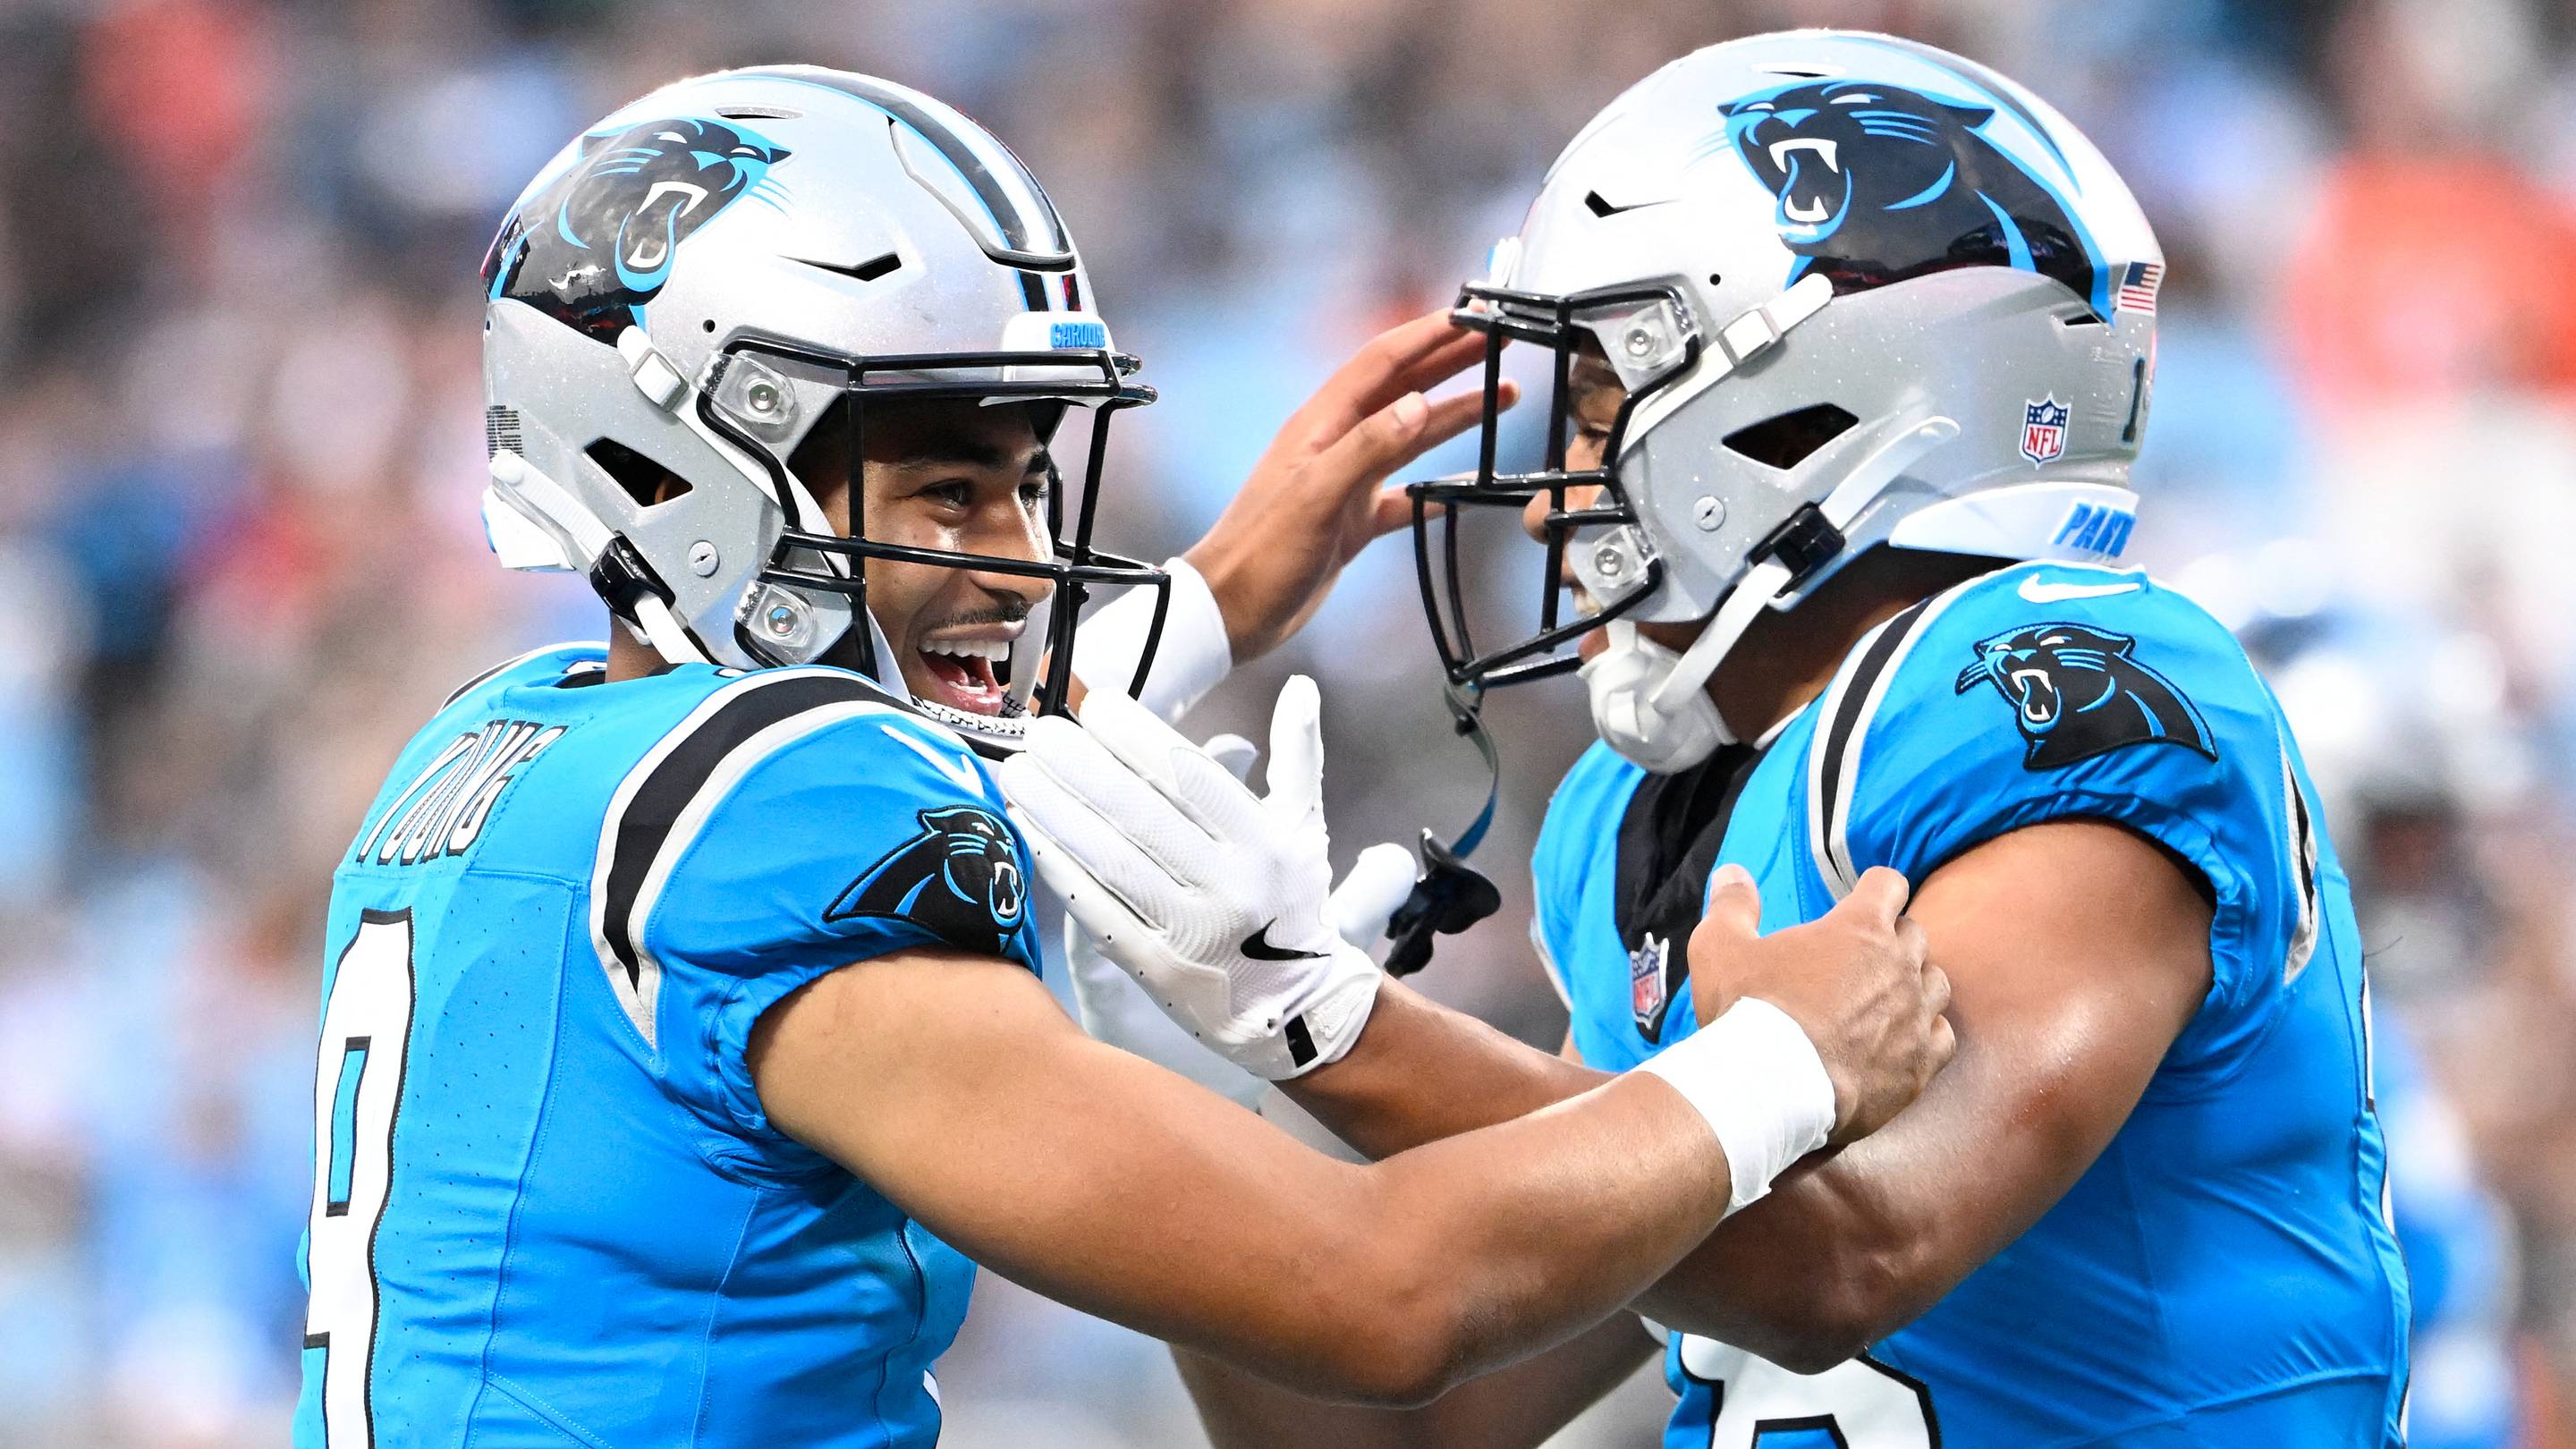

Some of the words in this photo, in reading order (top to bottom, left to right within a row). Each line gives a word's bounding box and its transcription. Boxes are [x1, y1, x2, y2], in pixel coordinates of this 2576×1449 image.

[2026, 426, 2060, 457] NFL
[356, 718, 570, 866] YOUNG
[303, 905, 416, 1449] 9
